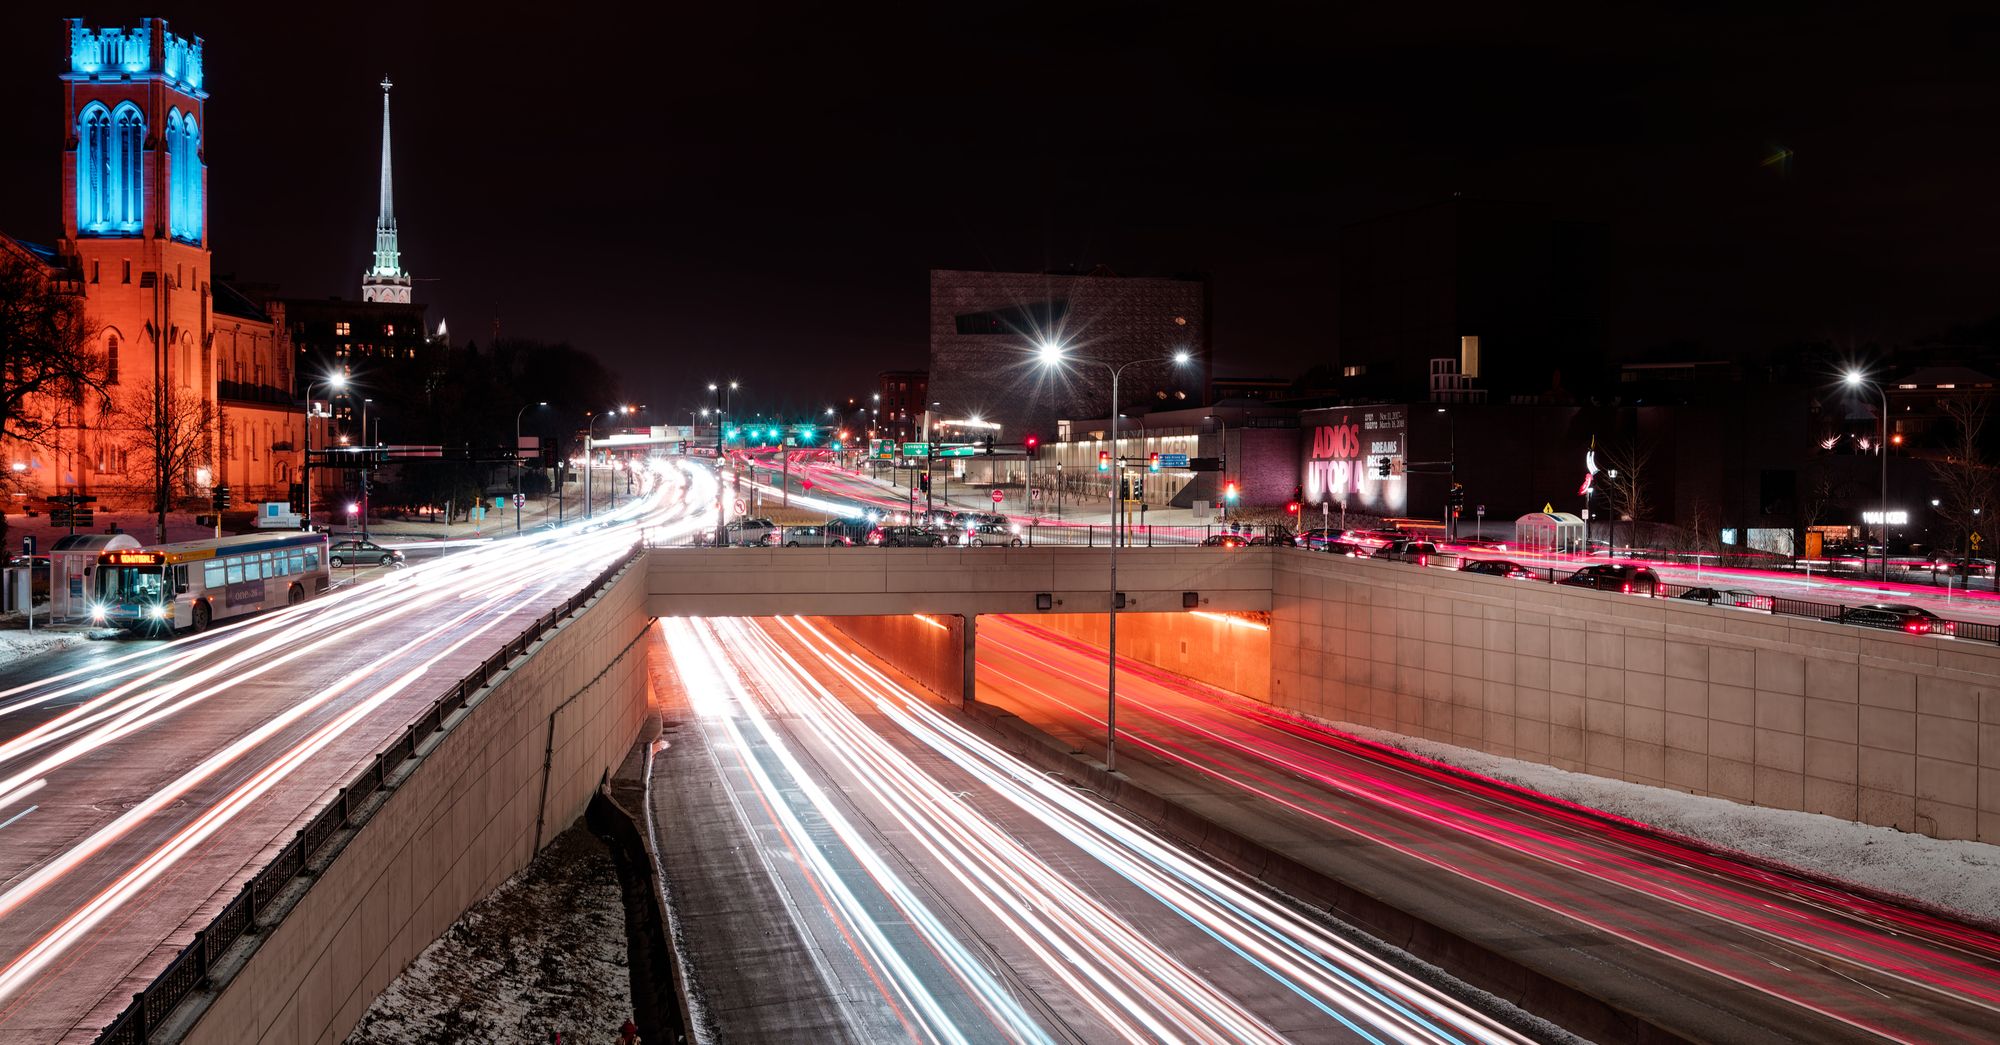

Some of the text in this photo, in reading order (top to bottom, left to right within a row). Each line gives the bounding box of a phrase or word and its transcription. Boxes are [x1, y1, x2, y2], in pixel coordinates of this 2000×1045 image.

[1312, 415, 1359, 459] ADIÓS
[1372, 441, 1397, 454] DREAMS
[1308, 460, 1365, 494] UTOPIA
[1862, 511, 1908, 524] WALKER
